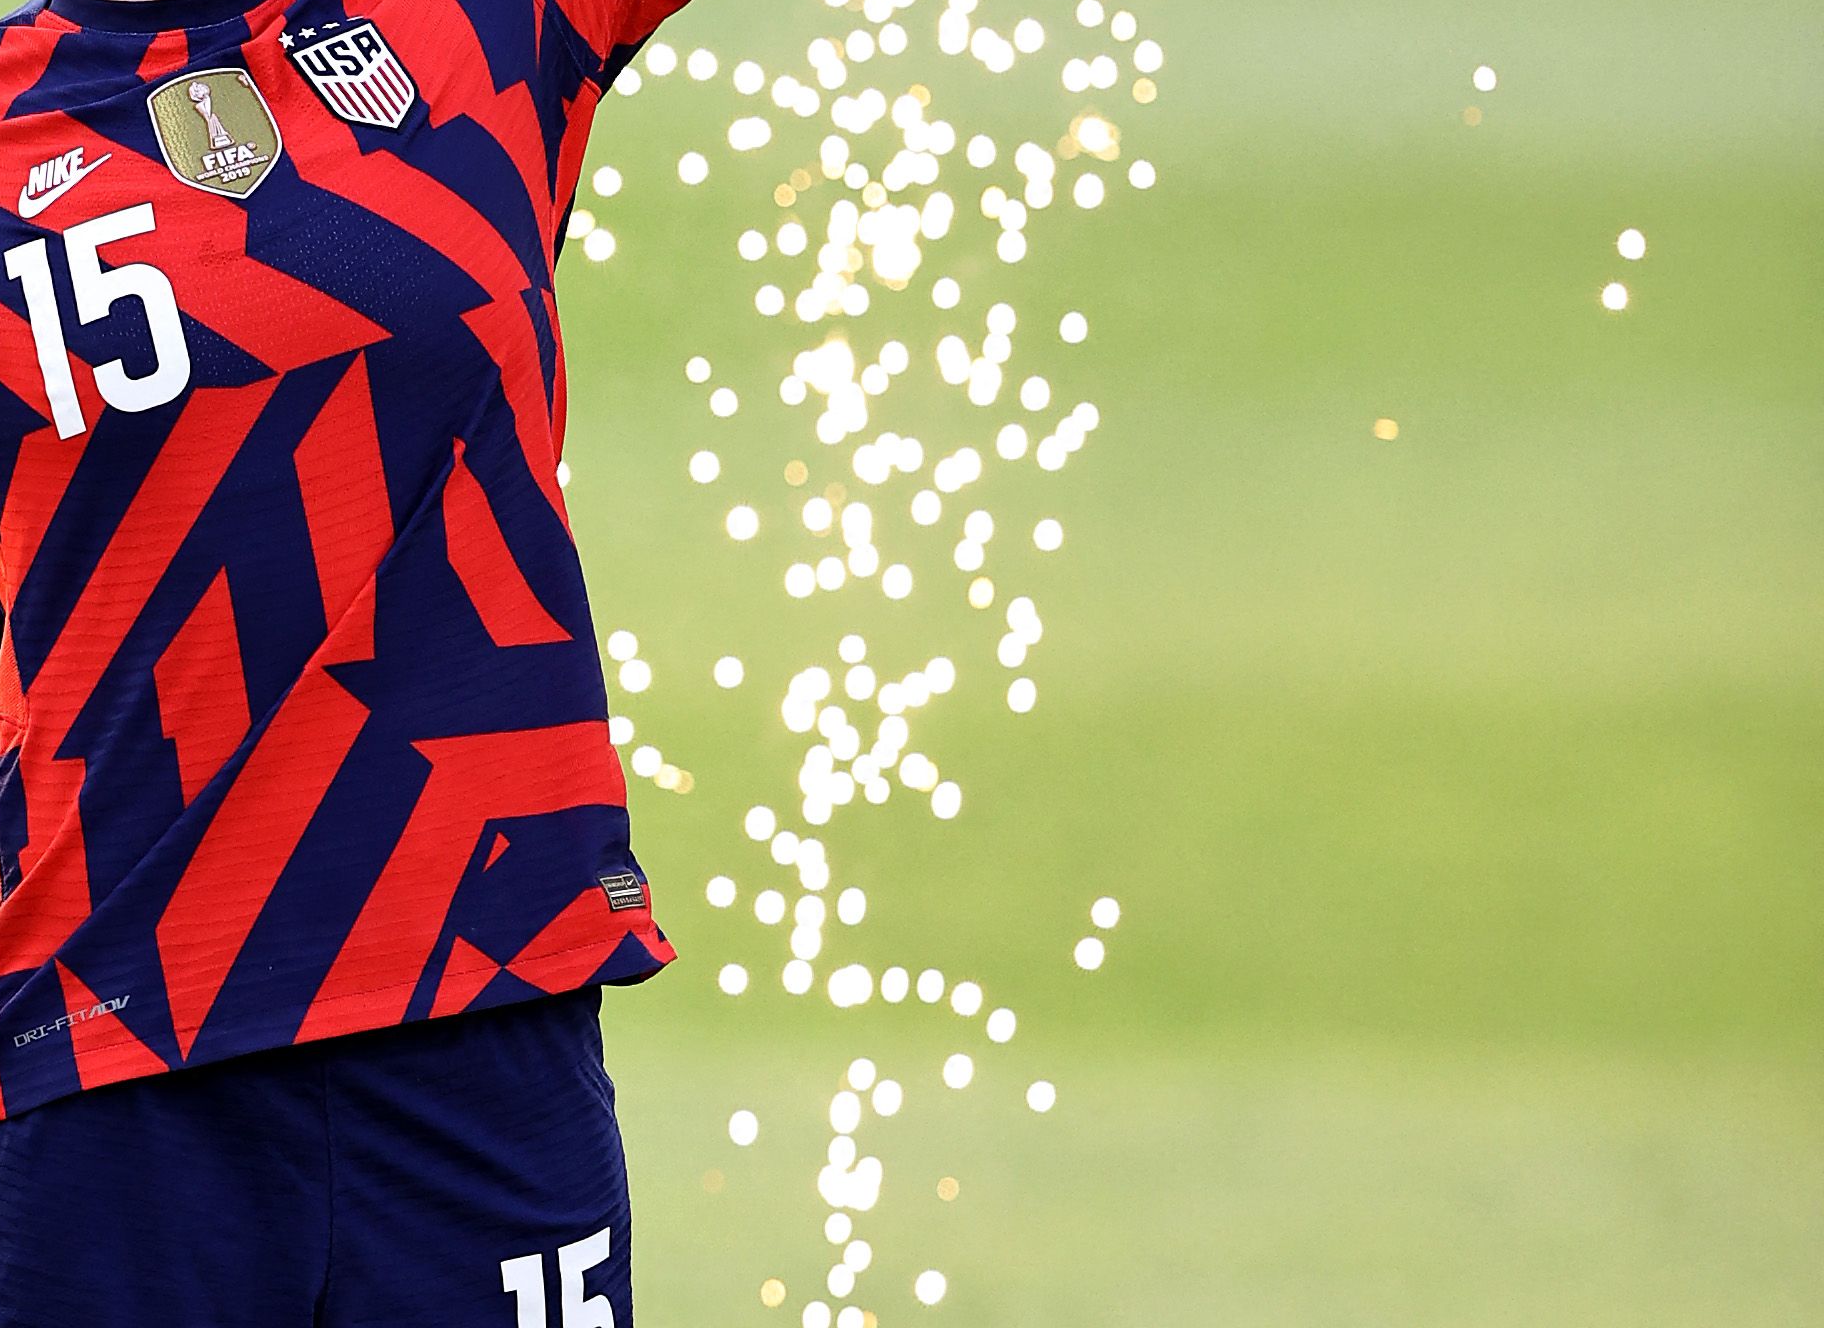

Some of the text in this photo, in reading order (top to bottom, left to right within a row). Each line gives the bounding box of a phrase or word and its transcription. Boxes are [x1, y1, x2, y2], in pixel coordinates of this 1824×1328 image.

[301, 29, 382, 77] USA
[27, 146, 84, 197] NIKE
[196, 167, 224, 181] WORLD
[202, 145, 255, 171] FIFA
[220, 166, 251, 183] 2019
[3, 202, 191, 441] 15
